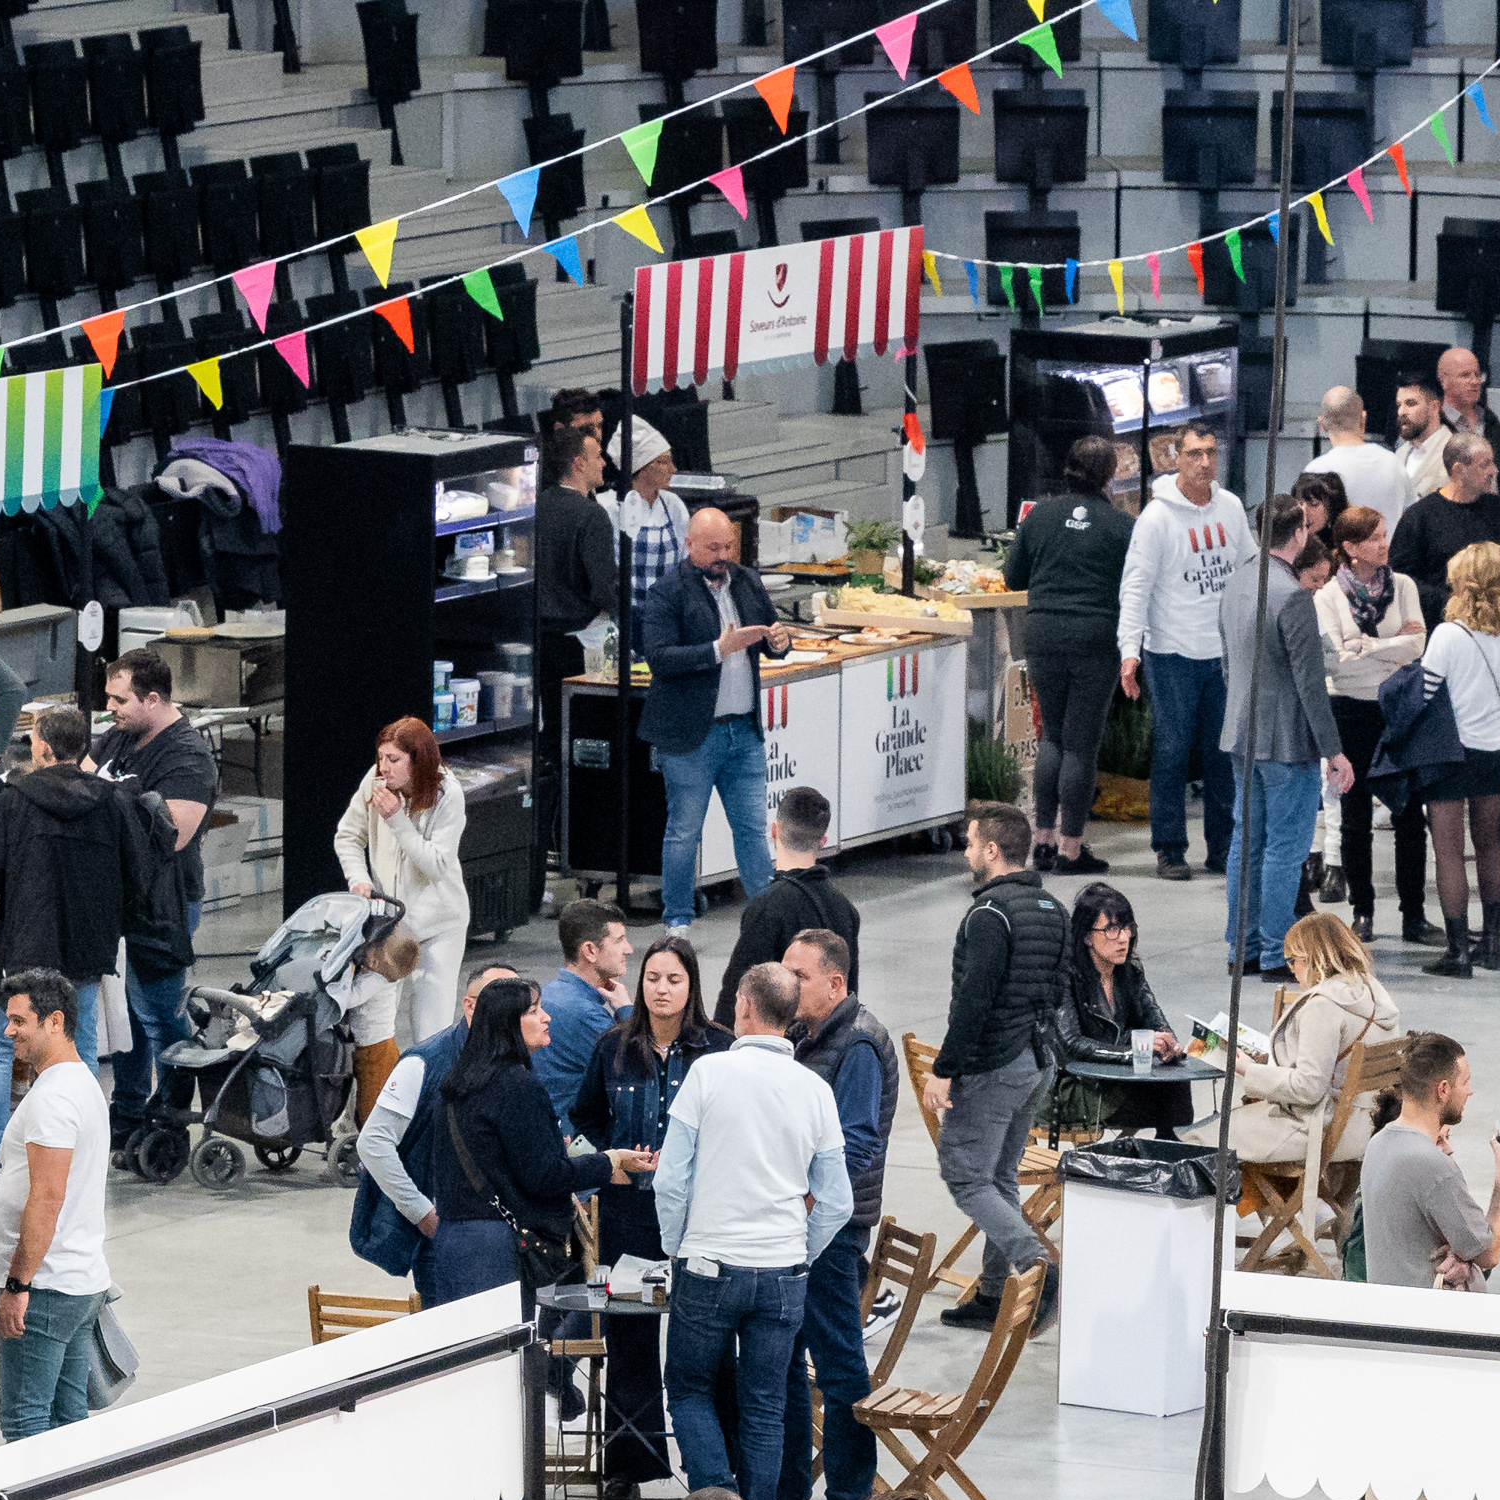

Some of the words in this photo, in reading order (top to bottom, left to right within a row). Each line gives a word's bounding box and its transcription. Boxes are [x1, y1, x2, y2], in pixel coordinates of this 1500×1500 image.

[892, 705, 910, 729] La
[875, 720, 927, 755] Grande
[886, 751, 924, 779] Place
